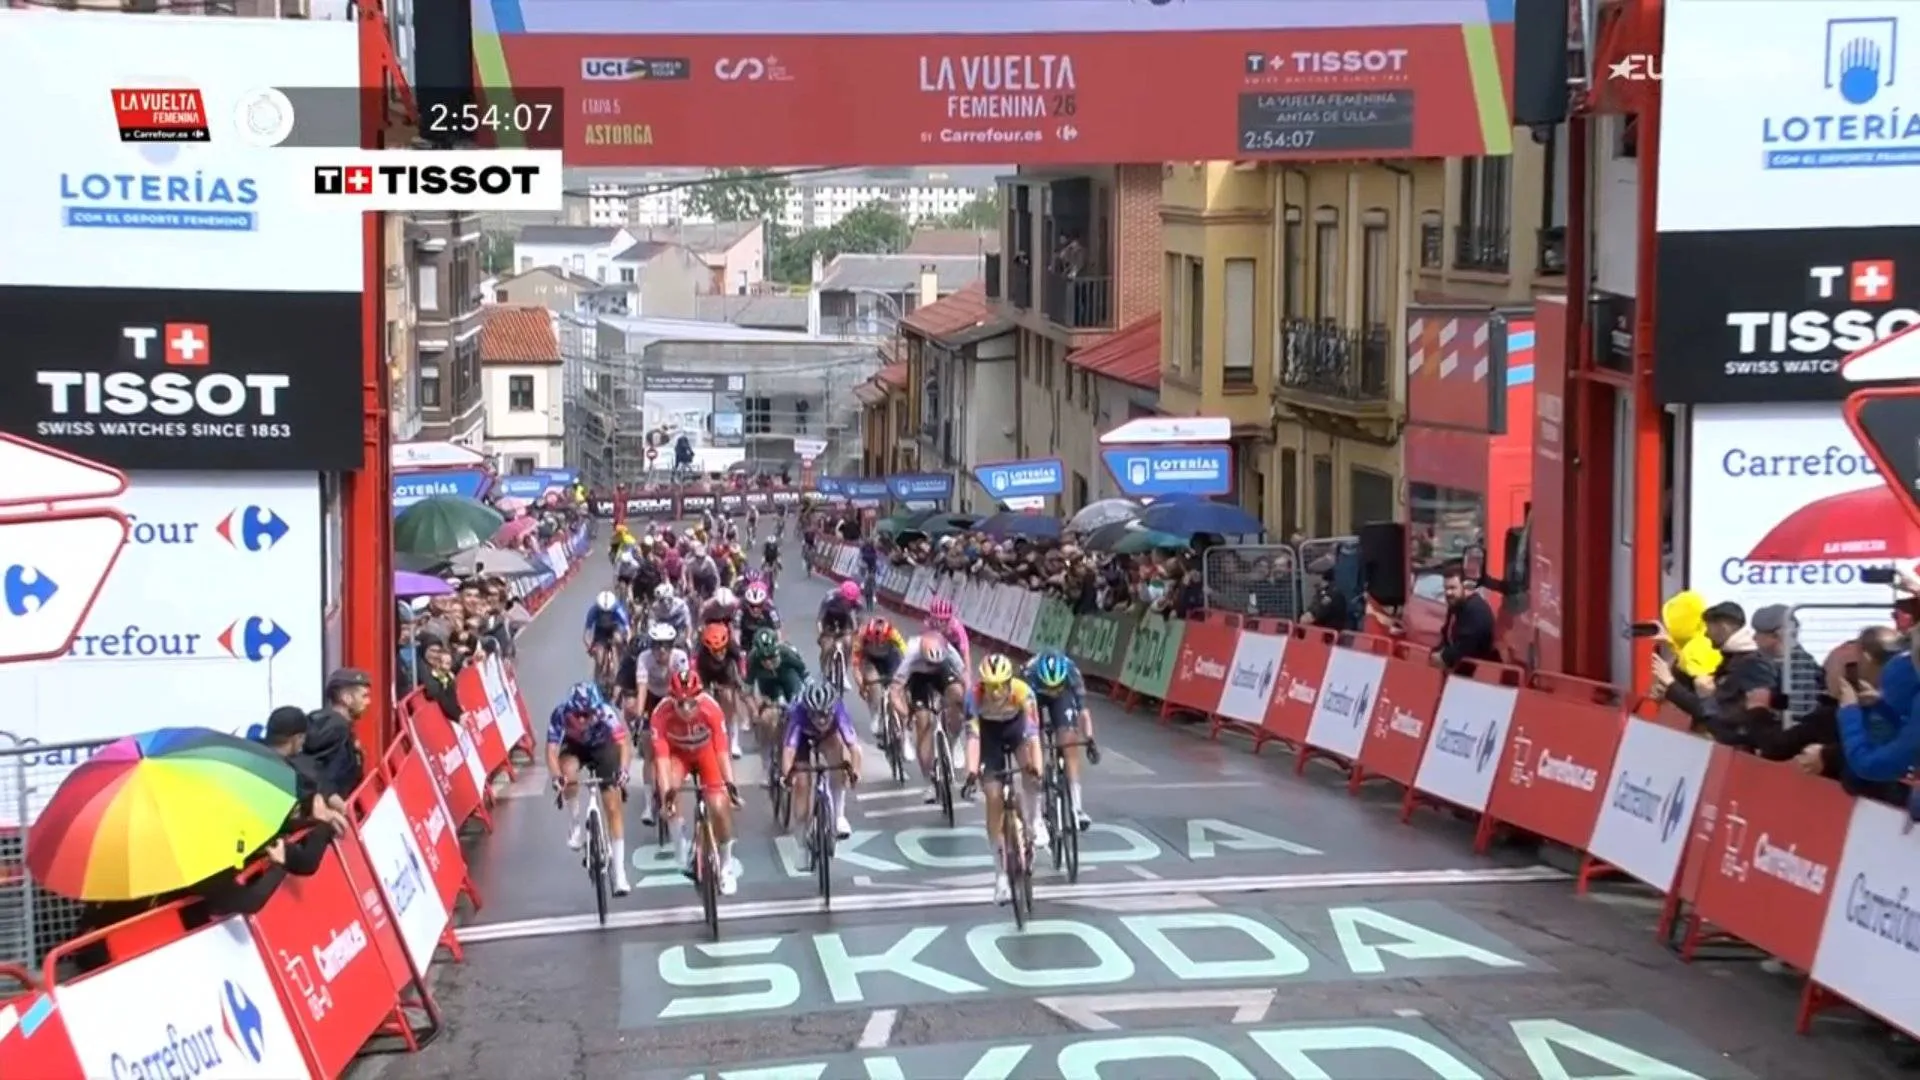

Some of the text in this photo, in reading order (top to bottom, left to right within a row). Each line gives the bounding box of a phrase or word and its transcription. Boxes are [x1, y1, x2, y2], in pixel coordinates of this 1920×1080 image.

[586, 62, 623, 76] UCI
[1291, 49, 1408, 72] TISSOT
[920, 55, 1076, 91] LA VUELTA
[947, 95, 1076, 118] FEMENINA 26
[585, 124, 653, 145] ASTORGA
[940, 127, 1043, 143] Carrefour.es
[1244, 130, 1316, 149] 2:54:07
[60, 170, 259, 204] LOTERÍAS
[1725, 361, 1779, 375] SWISS
[37, 371, 290, 416] TISSOT
[37, 421, 291, 438] SWISS WATCHES SINCE 1853
[1153, 457, 1219, 472] LOTERÍAS
